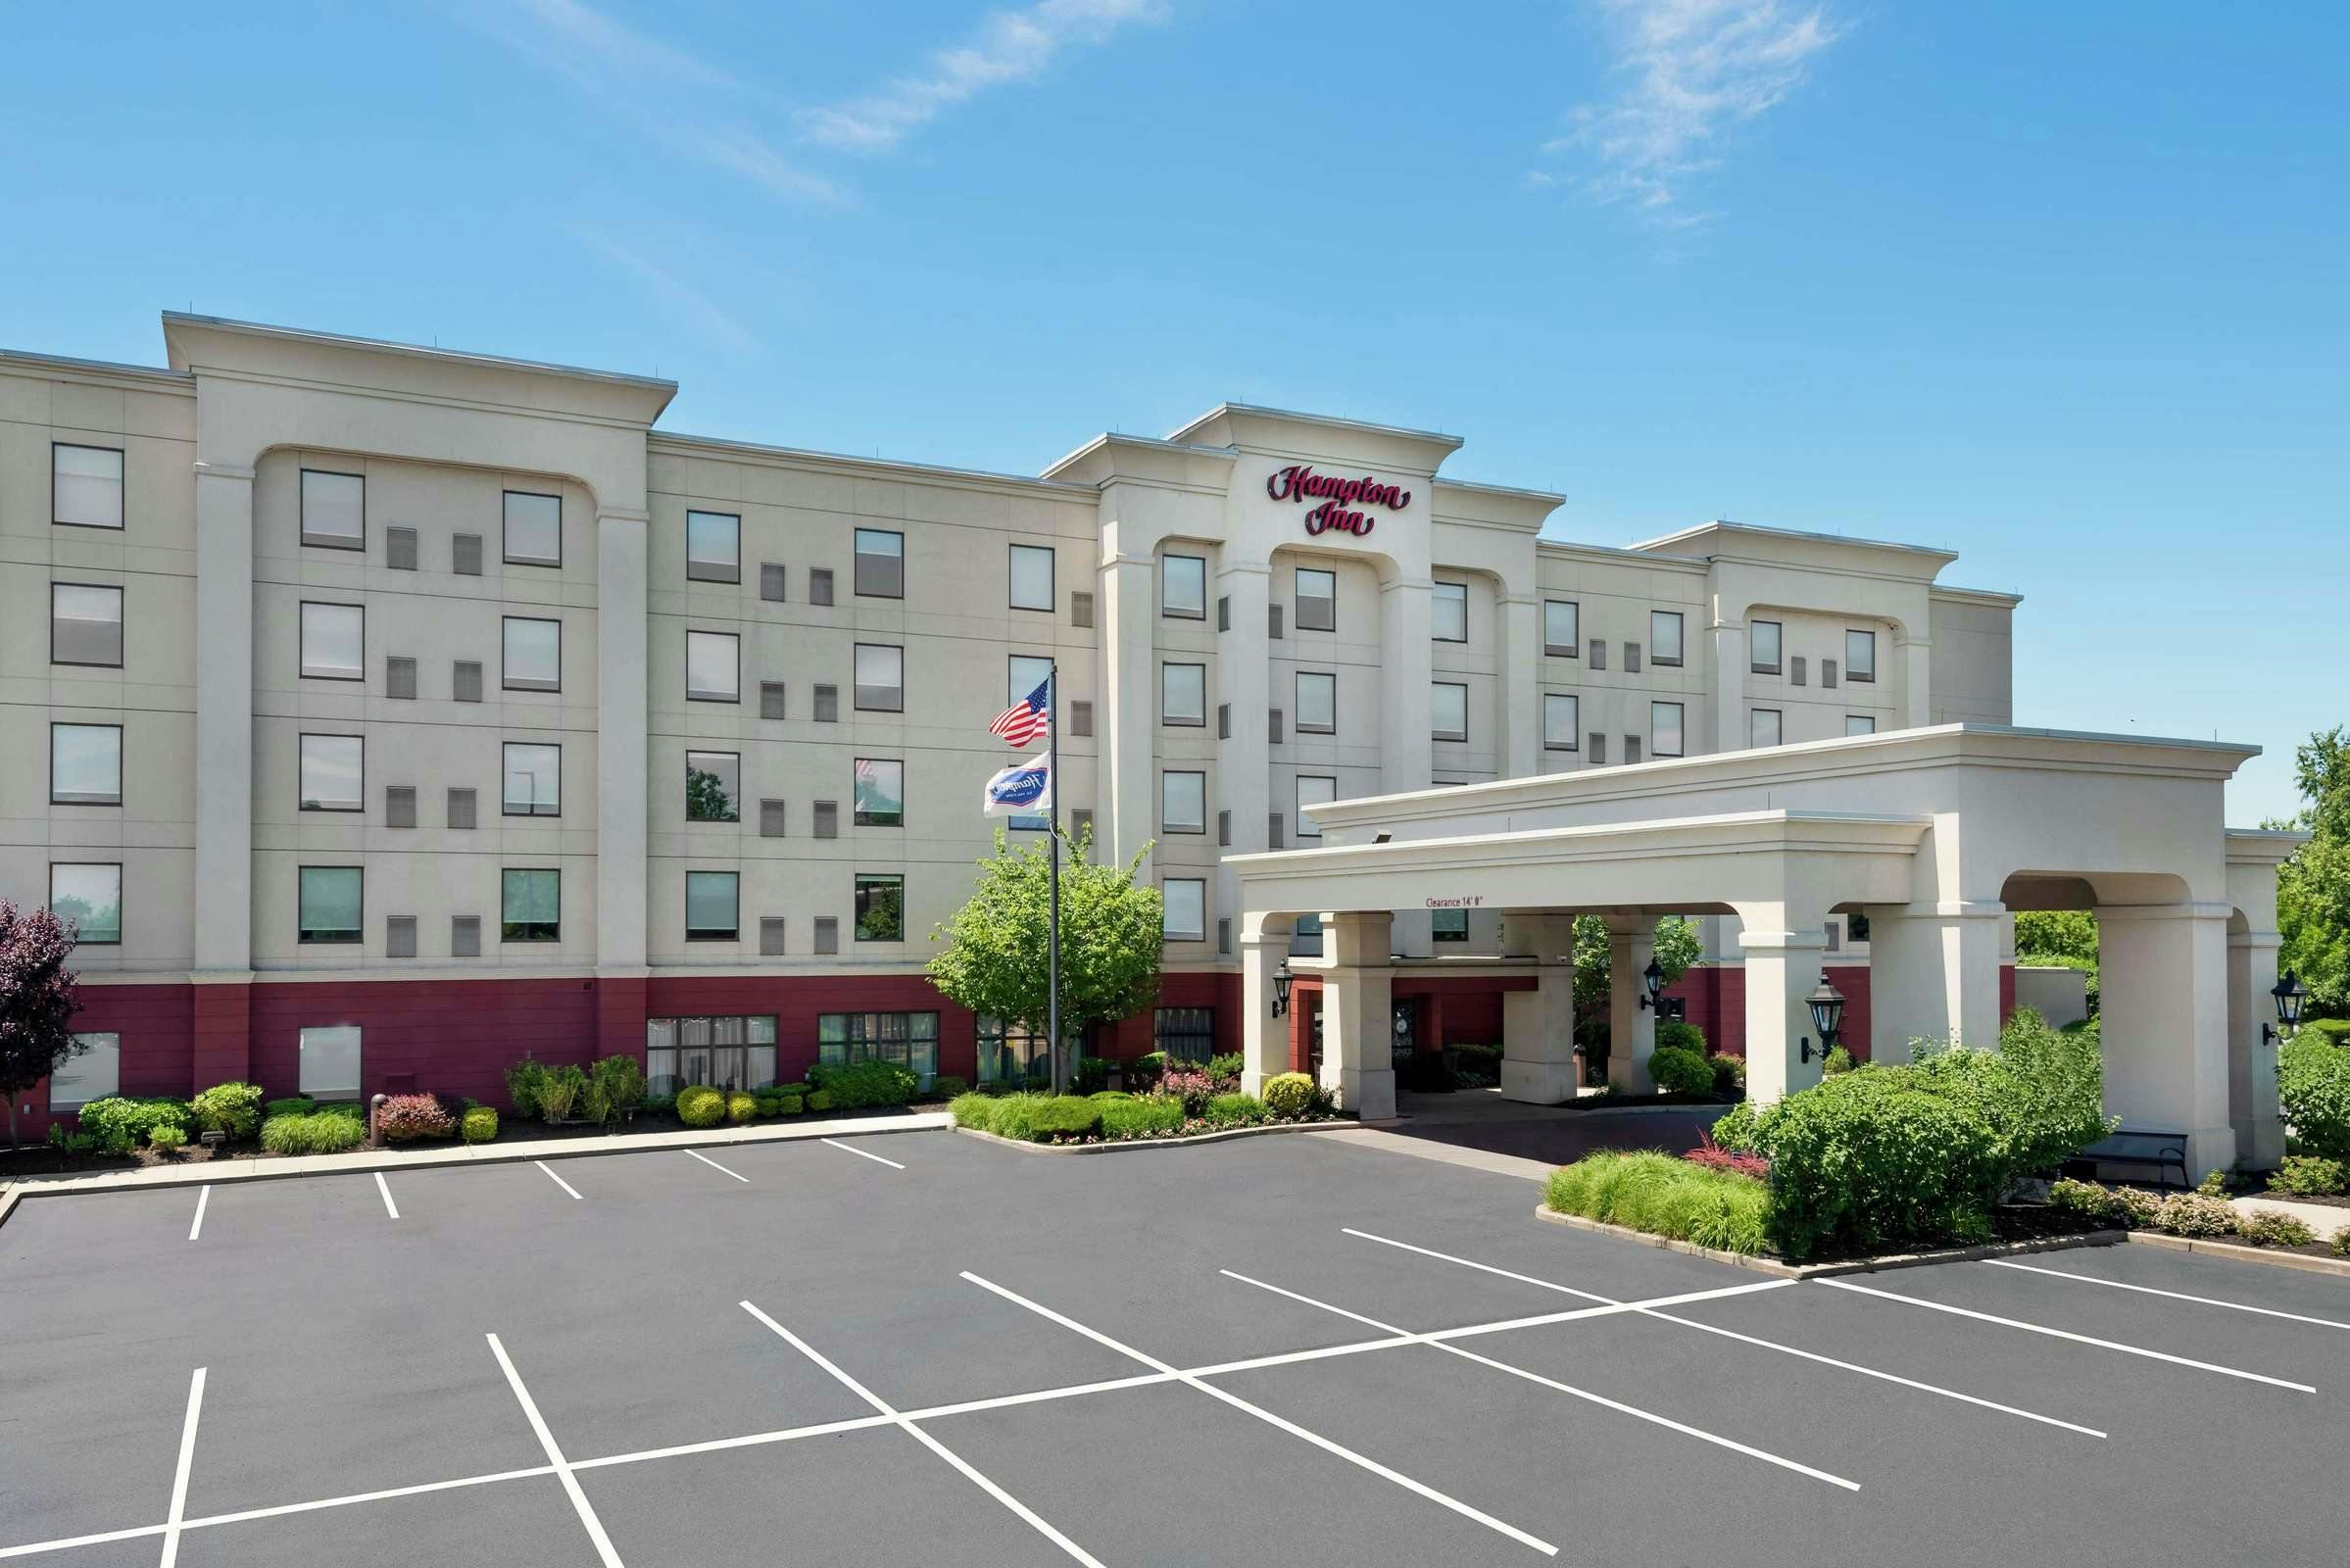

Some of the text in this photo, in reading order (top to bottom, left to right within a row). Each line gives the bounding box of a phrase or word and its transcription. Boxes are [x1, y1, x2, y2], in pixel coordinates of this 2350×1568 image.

[1267, 466, 1411, 510] Hampton
[1305, 501, 1374, 536] Inn
[1426, 898, 1460, 907] Clearance
